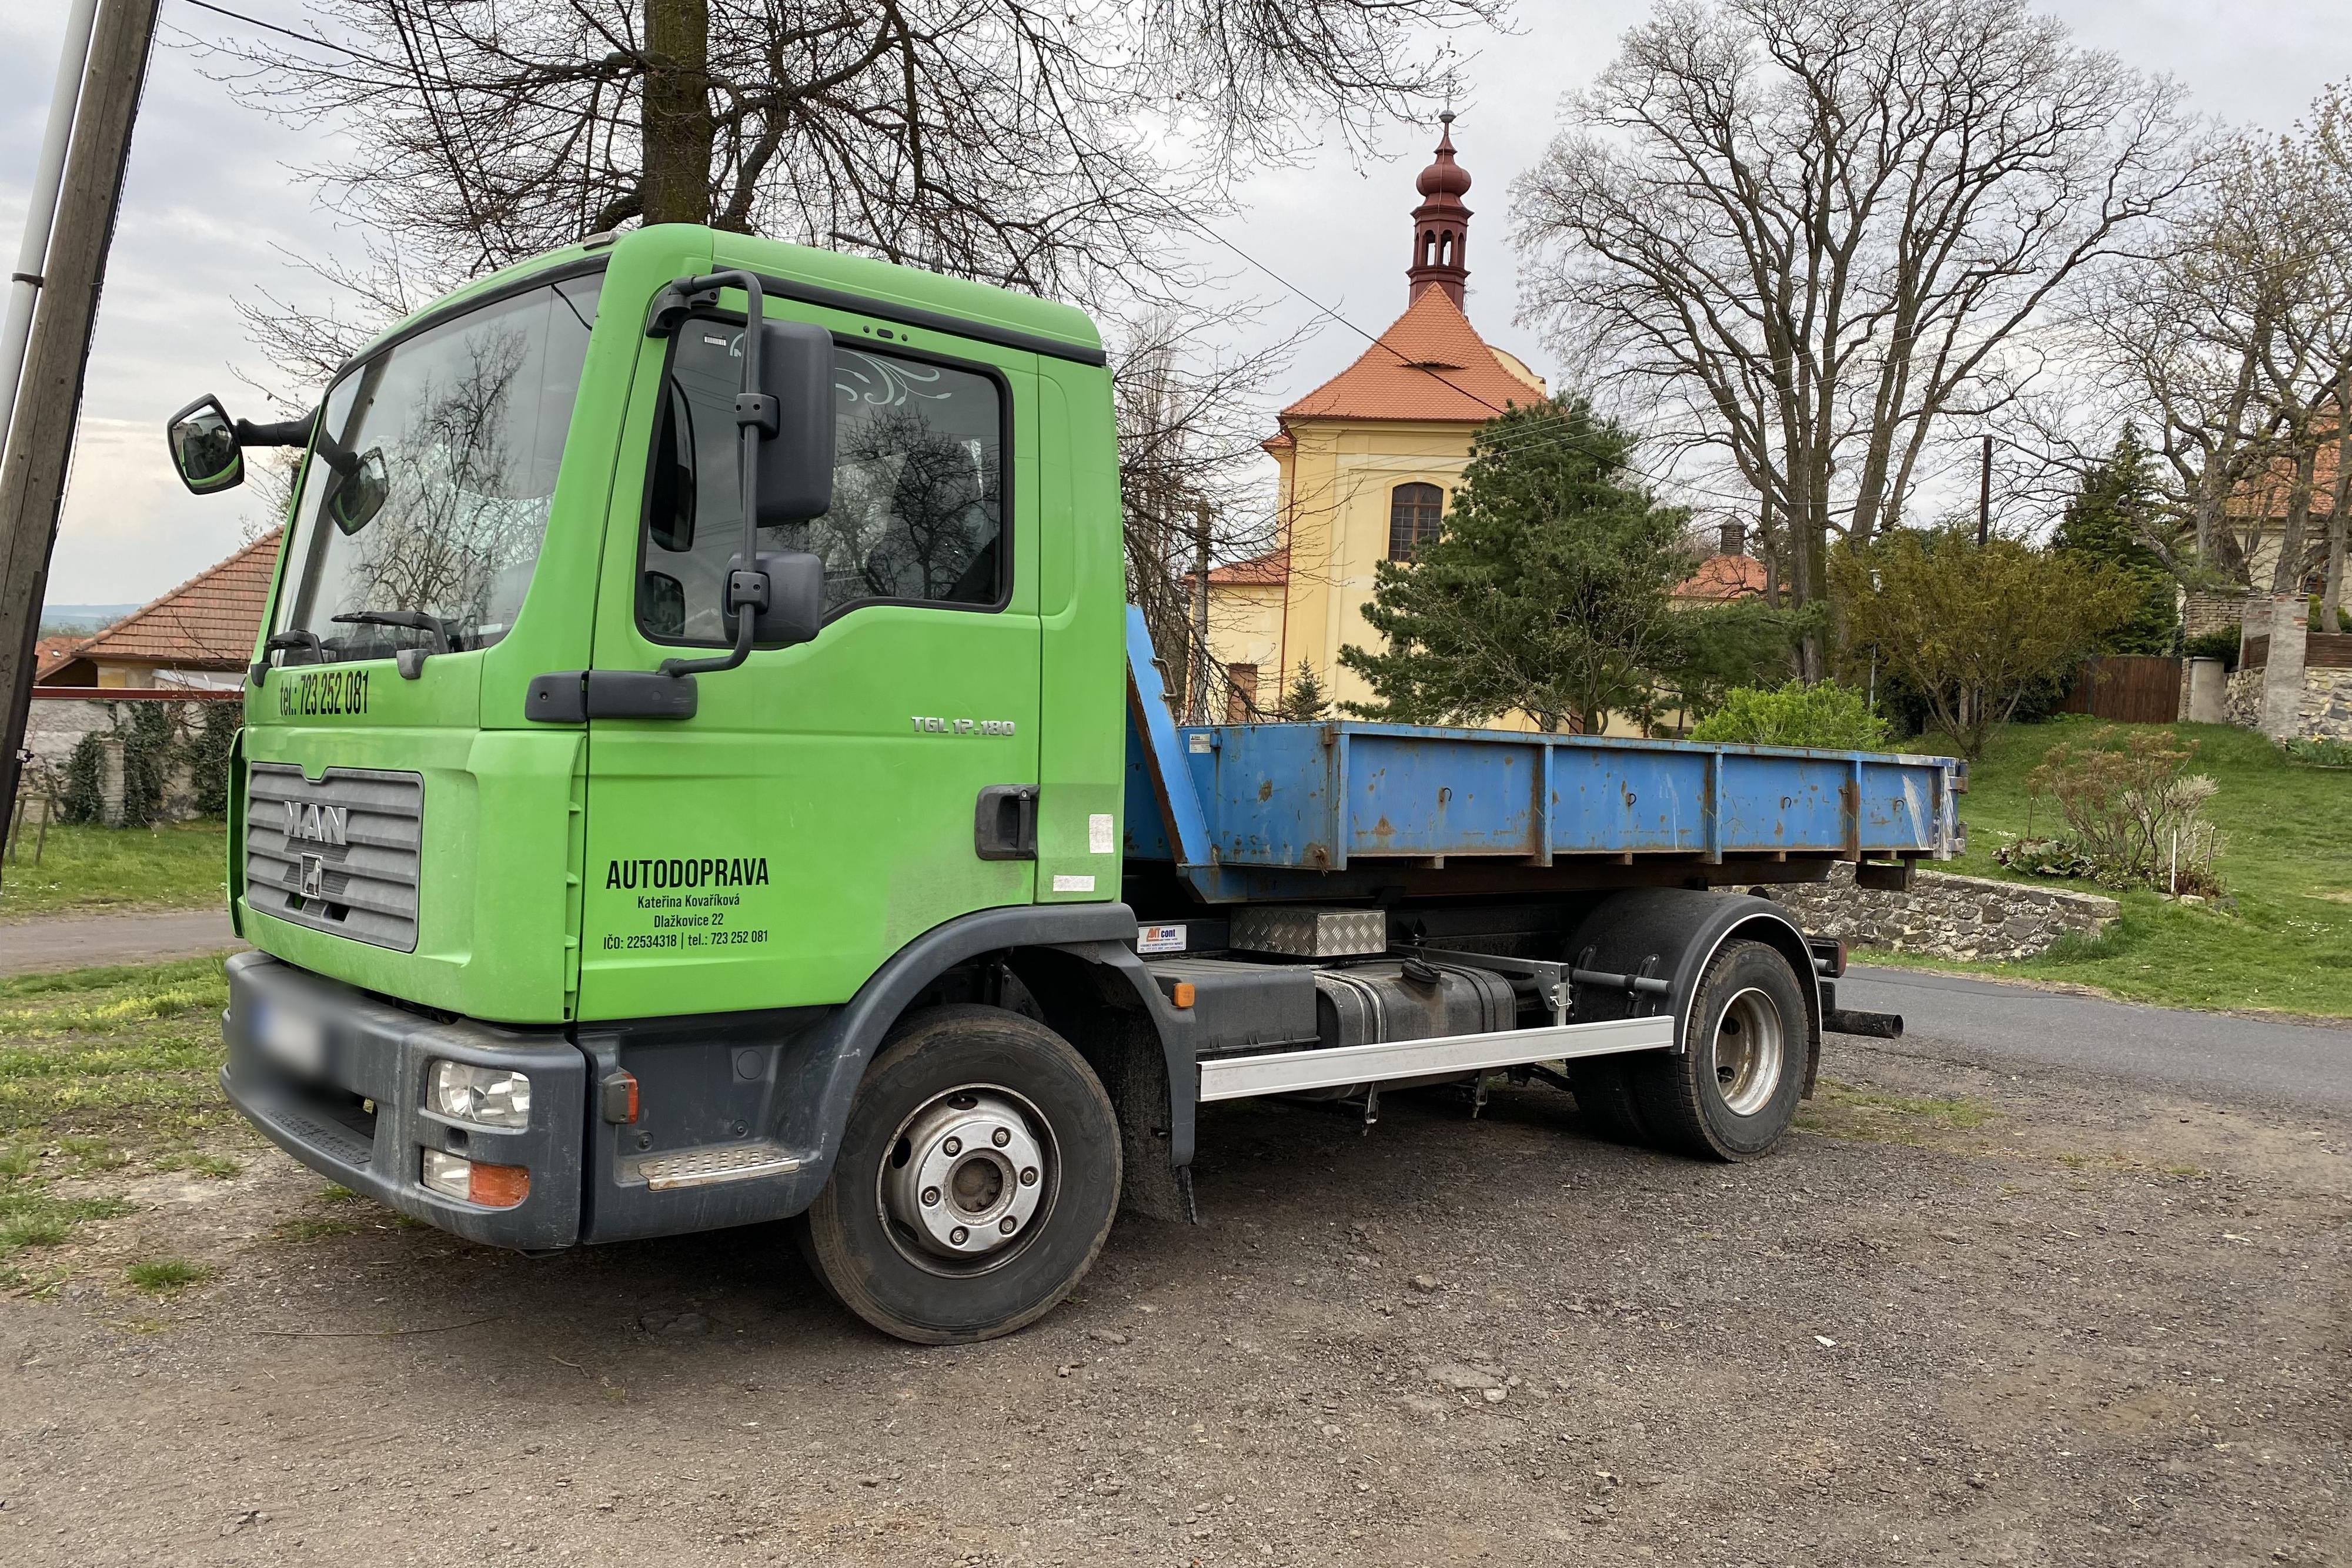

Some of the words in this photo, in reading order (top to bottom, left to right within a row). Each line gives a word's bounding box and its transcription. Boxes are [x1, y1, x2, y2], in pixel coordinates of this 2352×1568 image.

[280, 677, 296, 716] tel.:
[300, 674, 318, 715] 723
[320, 672, 342, 714] 252
[345, 670, 369, 714] 081
[911, 717, 948, 733] TGL
[283, 800, 346, 845] MAN
[606, 858, 769, 889] AUTODOPRAVA
[637, 895, 682, 908] Kateřina
[685, 893, 740, 907] Kovaříková
[654, 914, 709, 928] Dlažkovice
[711, 913, 724, 925] 22
[603, 934, 623, 950] IČO:
[627, 934, 677, 949] 22534318
[688, 933, 707, 946] tel.:
[711, 932, 728, 945] 723
[731, 931, 749, 944] 252
[751, 930, 767, 942] 081
